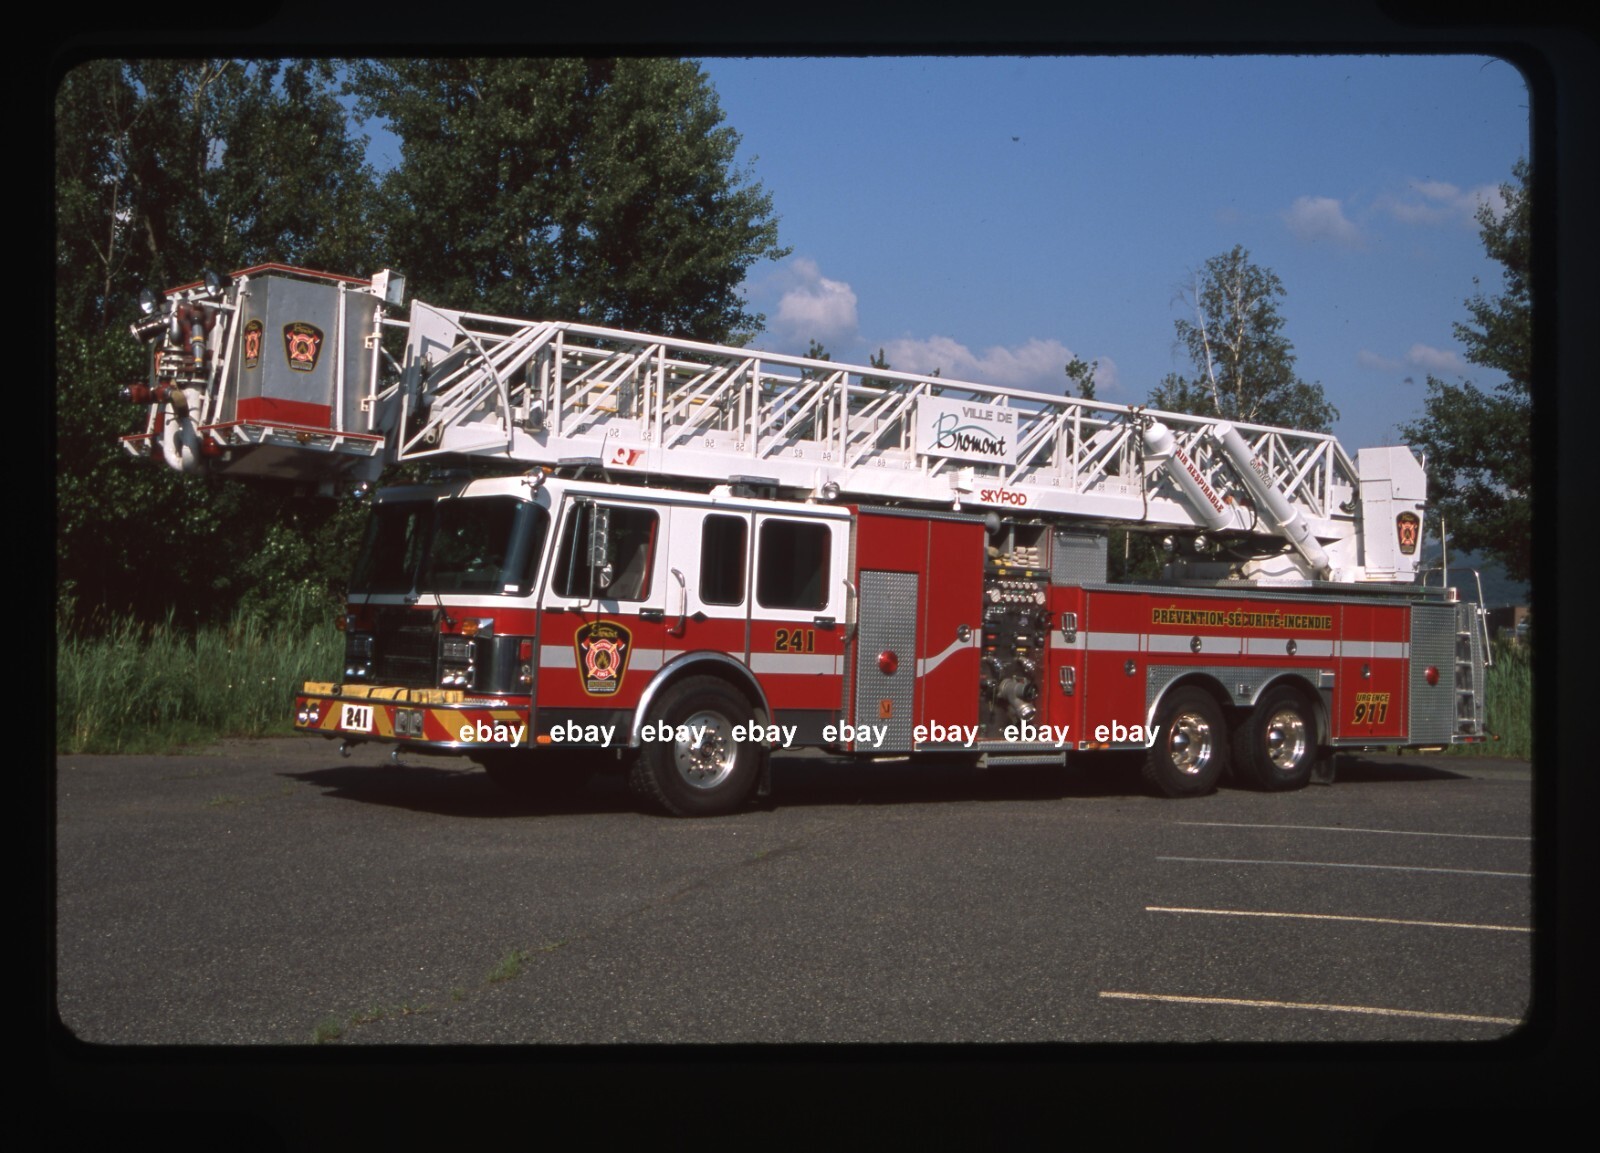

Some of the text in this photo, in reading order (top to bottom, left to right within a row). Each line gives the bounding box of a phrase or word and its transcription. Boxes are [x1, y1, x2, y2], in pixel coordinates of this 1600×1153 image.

[962, 407, 1012, 424] VILLE DE
[928, 412, 1007, 456] Bromont
[1176, 448, 1225, 513] AIR RESPIRABLE
[980, 487, 1027, 506] SKYPOD
[775, 628, 815, 653] 241
[1356, 693, 1390, 702] URGENCE
[346, 706, 368, 729] 241
[1352, 702, 1388, 724] 911
